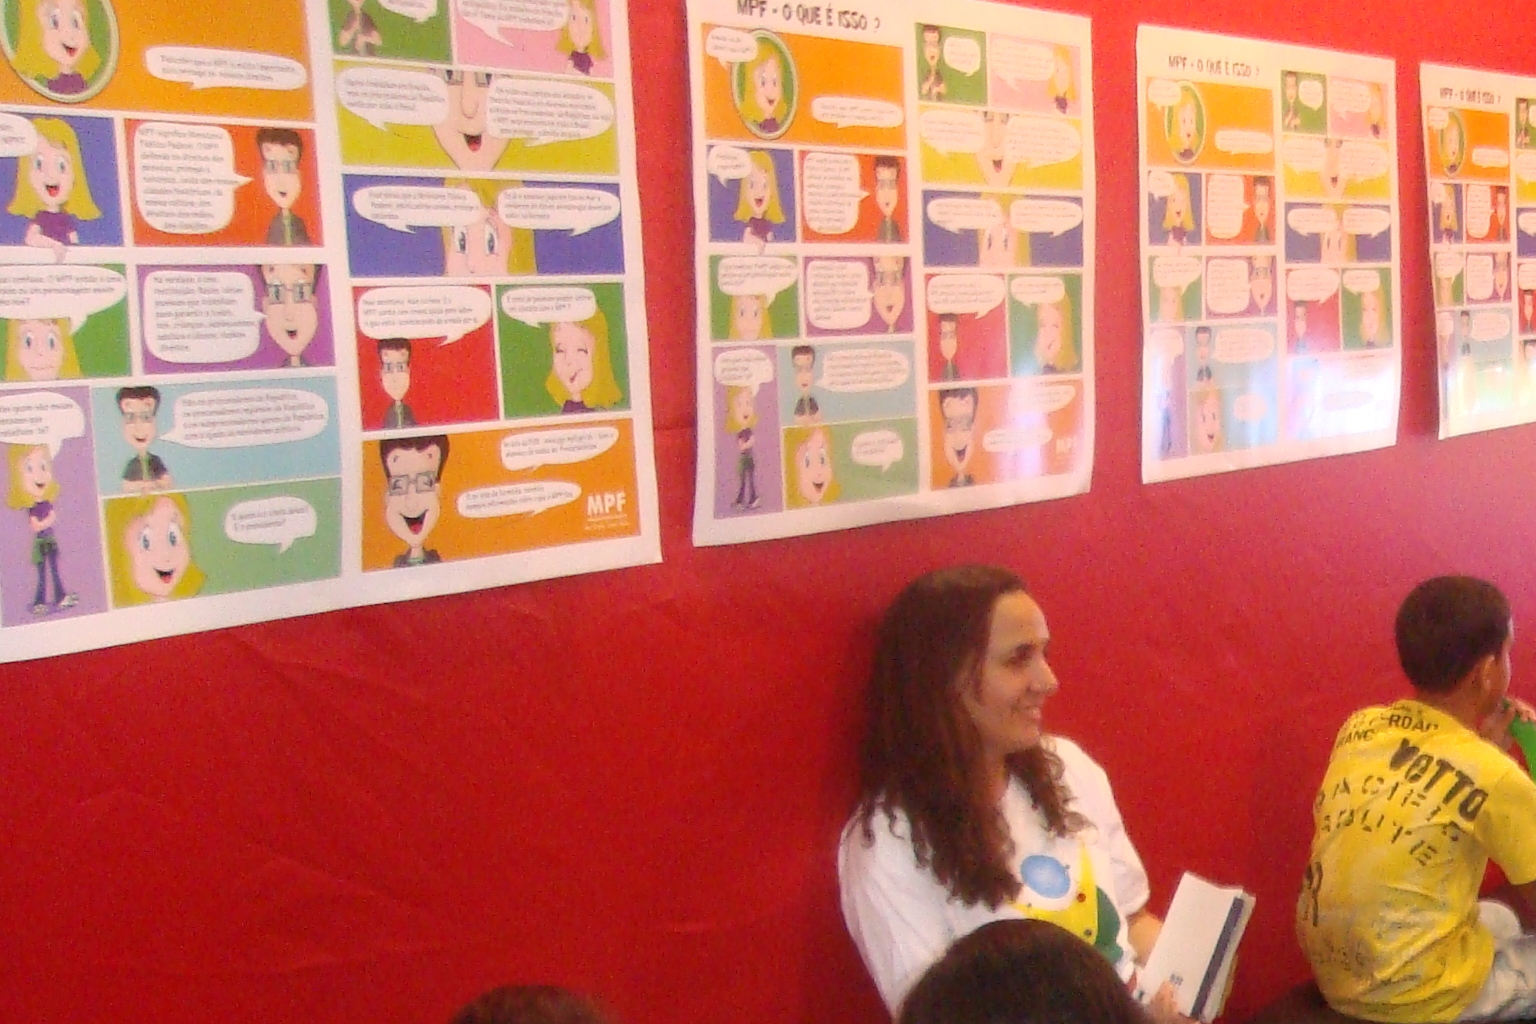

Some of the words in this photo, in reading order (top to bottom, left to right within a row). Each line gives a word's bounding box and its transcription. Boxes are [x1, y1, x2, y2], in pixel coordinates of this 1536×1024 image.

[737, 0, 767, 18] MPF
[782, 4, 792, 21] O
[796, 4, 821, 26] QUE
[826, 3, 833, 27] É
[838, 10, 868, 30] ISSO
[586, 491, 627, 517] MPF
